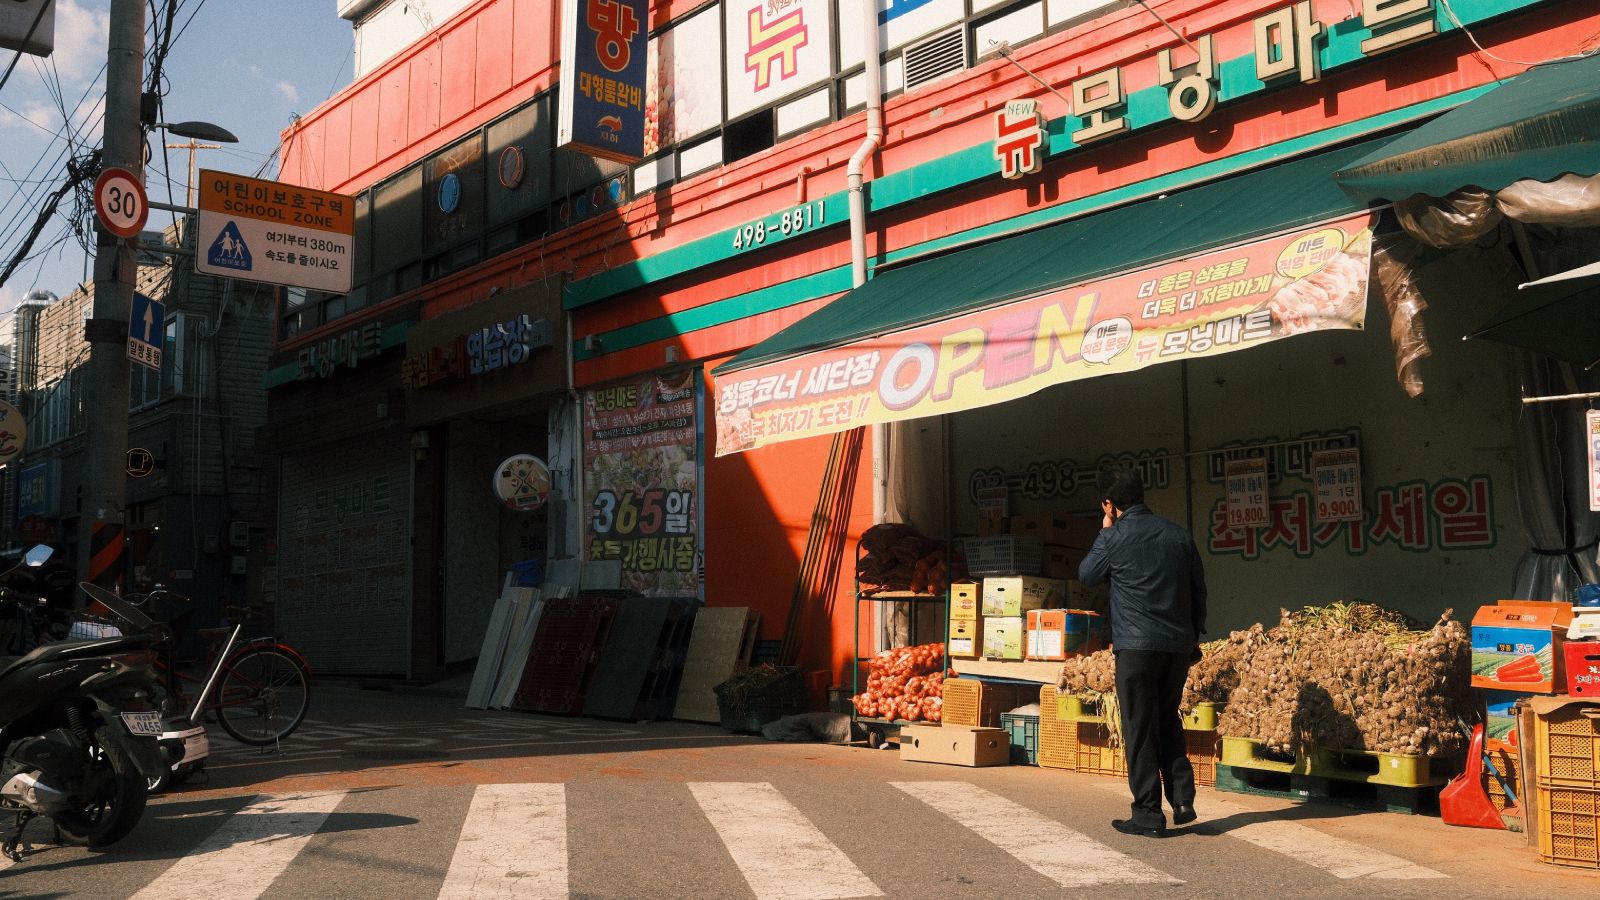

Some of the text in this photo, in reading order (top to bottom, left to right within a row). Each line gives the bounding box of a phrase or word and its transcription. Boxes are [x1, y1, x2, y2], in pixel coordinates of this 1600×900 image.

[745, 4, 808, 93] 뉴
[579, 71, 642, 112] 대형룸완비
[995, 0, 1441, 178] 뉴 모닝마트
[1005, 101, 1033, 115] NEW
[108, 186, 136, 219] 30
[213, 179, 344, 216] 어린이보호구역
[223, 200, 333, 228] SCHOOL ZONE
[266, 231, 345, 255] 여기부터 380m
[733, 201, 825, 250] 498-8811
[1296, 233, 1325, 249] 마트
[264, 250, 339, 270] 속도를 줄이시오
[1137, 257, 1249, 299] 더 좋은 상품을
[1141, 274, 1273, 320] 더욱 더 저렴하게
[1096, 323, 1119, 337] 마트
[1159, 310, 1272, 357] 모닝마트
[130, 340, 161, 366] 일방통행
[878, 291, 1099, 411] OPEN
[720, 351, 880, 413] 정육코너 새단장
[767, 408, 814, 434] 최저가
[816, 399, 854, 428] 도전
[592, 489, 691, 535] 365일
